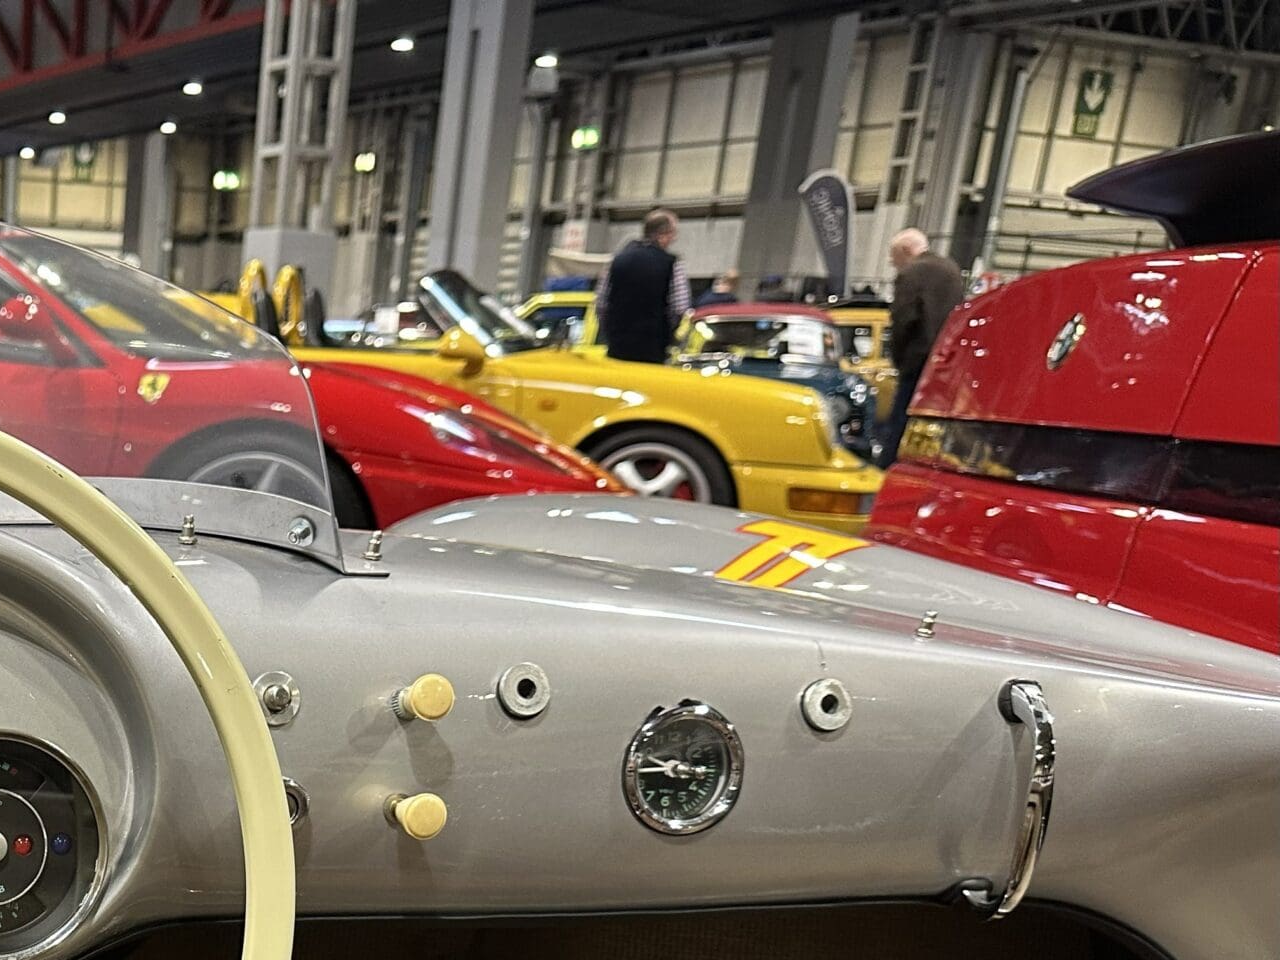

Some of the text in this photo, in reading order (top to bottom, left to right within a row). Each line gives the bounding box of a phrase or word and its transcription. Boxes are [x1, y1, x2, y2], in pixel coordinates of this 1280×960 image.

[646, 791, 655, 801] 7
[660, 796, 670, 807] 6
[677, 791, 687, 802] 5
